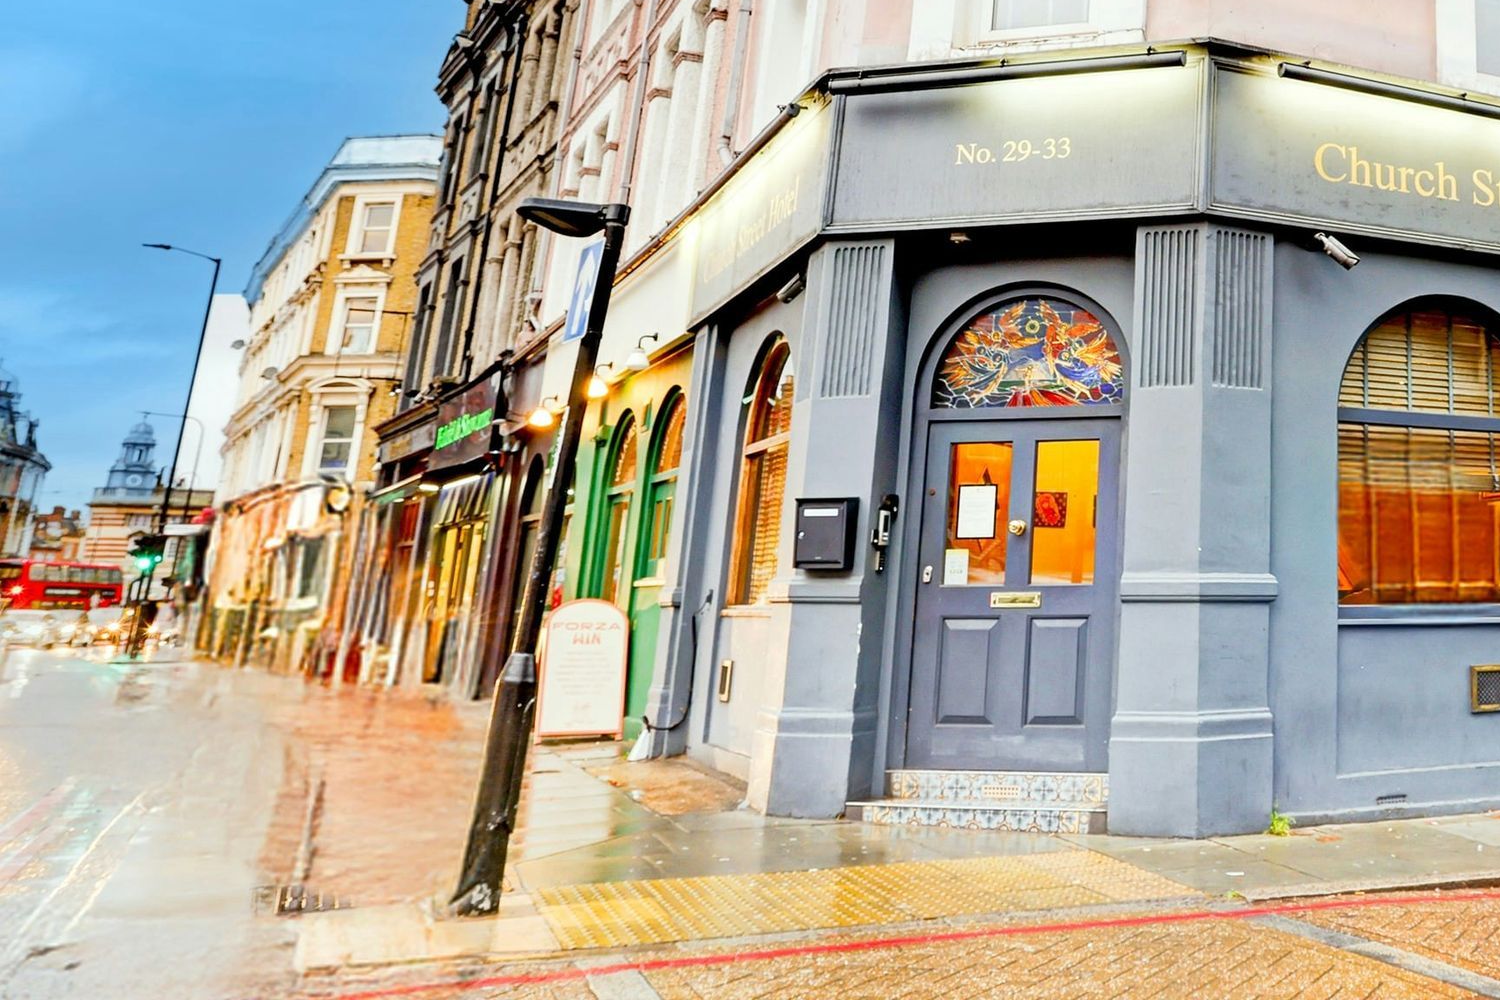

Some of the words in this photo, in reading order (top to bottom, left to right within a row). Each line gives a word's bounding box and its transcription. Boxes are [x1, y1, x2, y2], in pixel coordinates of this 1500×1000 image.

[954, 142, 996, 165] No.
[1002, 137, 1071, 162] 29-33
[1313, 142, 1460, 202] Church
[768, 175, 800, 233] Hotel
[552, 621, 622, 631] FORZA
